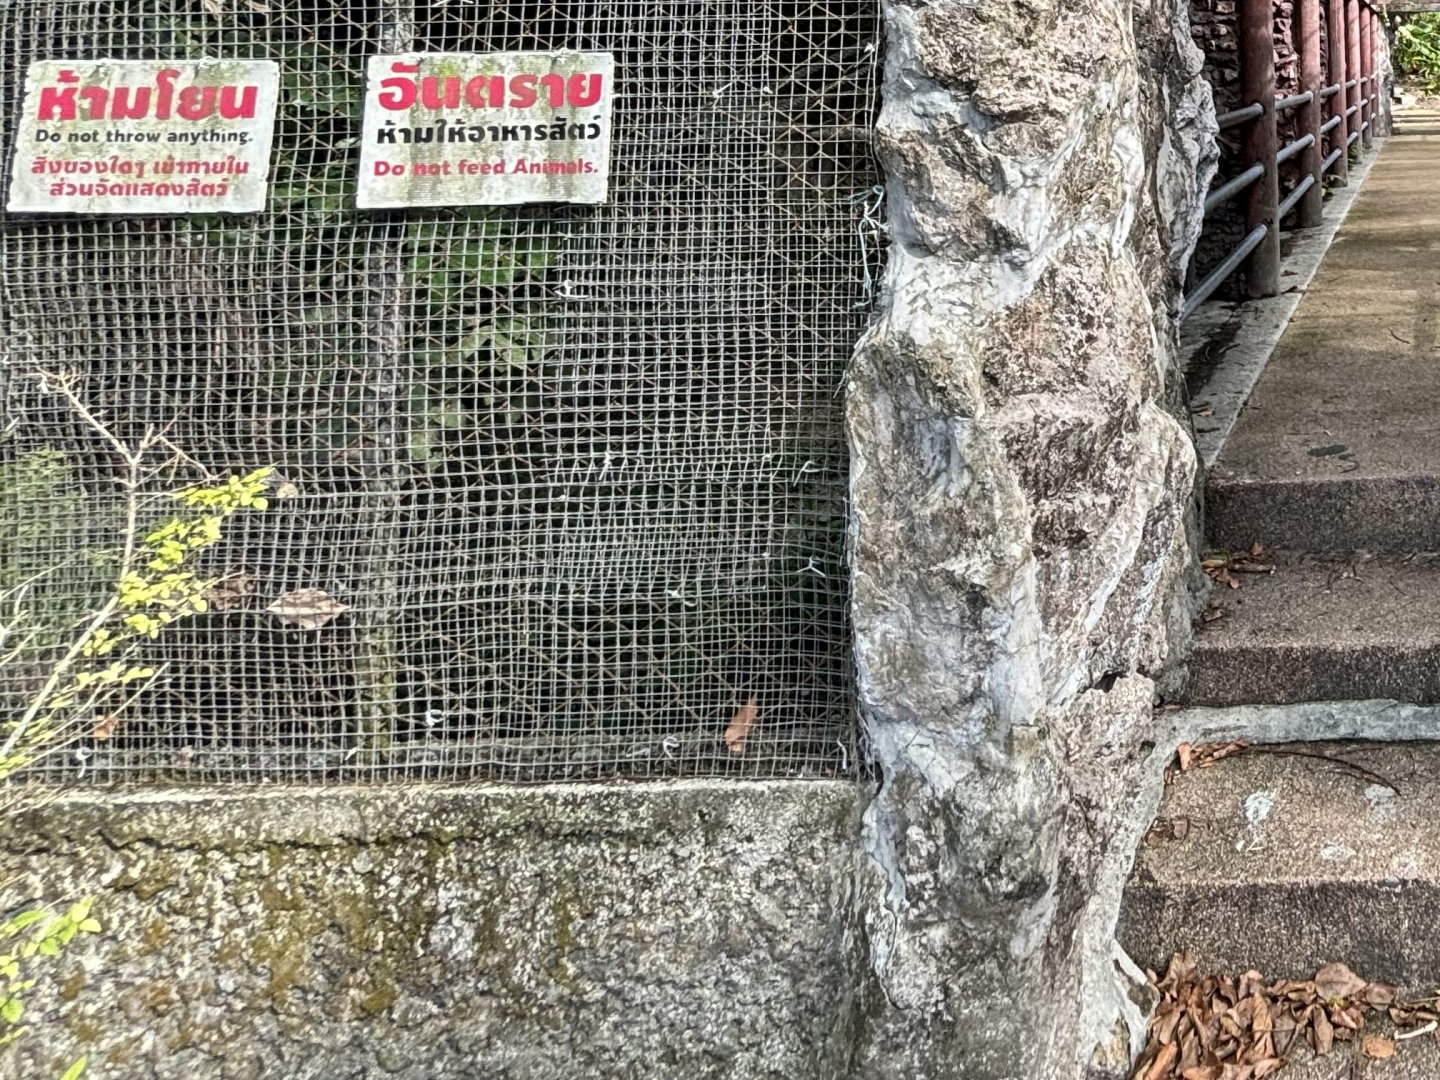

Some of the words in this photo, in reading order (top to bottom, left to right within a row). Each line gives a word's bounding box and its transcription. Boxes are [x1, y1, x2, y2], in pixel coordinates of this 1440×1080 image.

[37, 69, 258, 120] ห้ามโยน
[378, 62, 602, 110] อันตราย
[35, 129, 61, 143] Do
[68, 129, 98, 143] not
[106, 129, 160, 143] throw
[167, 128, 254, 144] anything.
[377, 115, 601, 144] ห้ามให้อาหารสัตว์
[374, 161, 405, 176] Do
[412, 160, 450, 175] not
[458, 158, 505, 175] feed
[512, 158, 599, 174] Animals.
